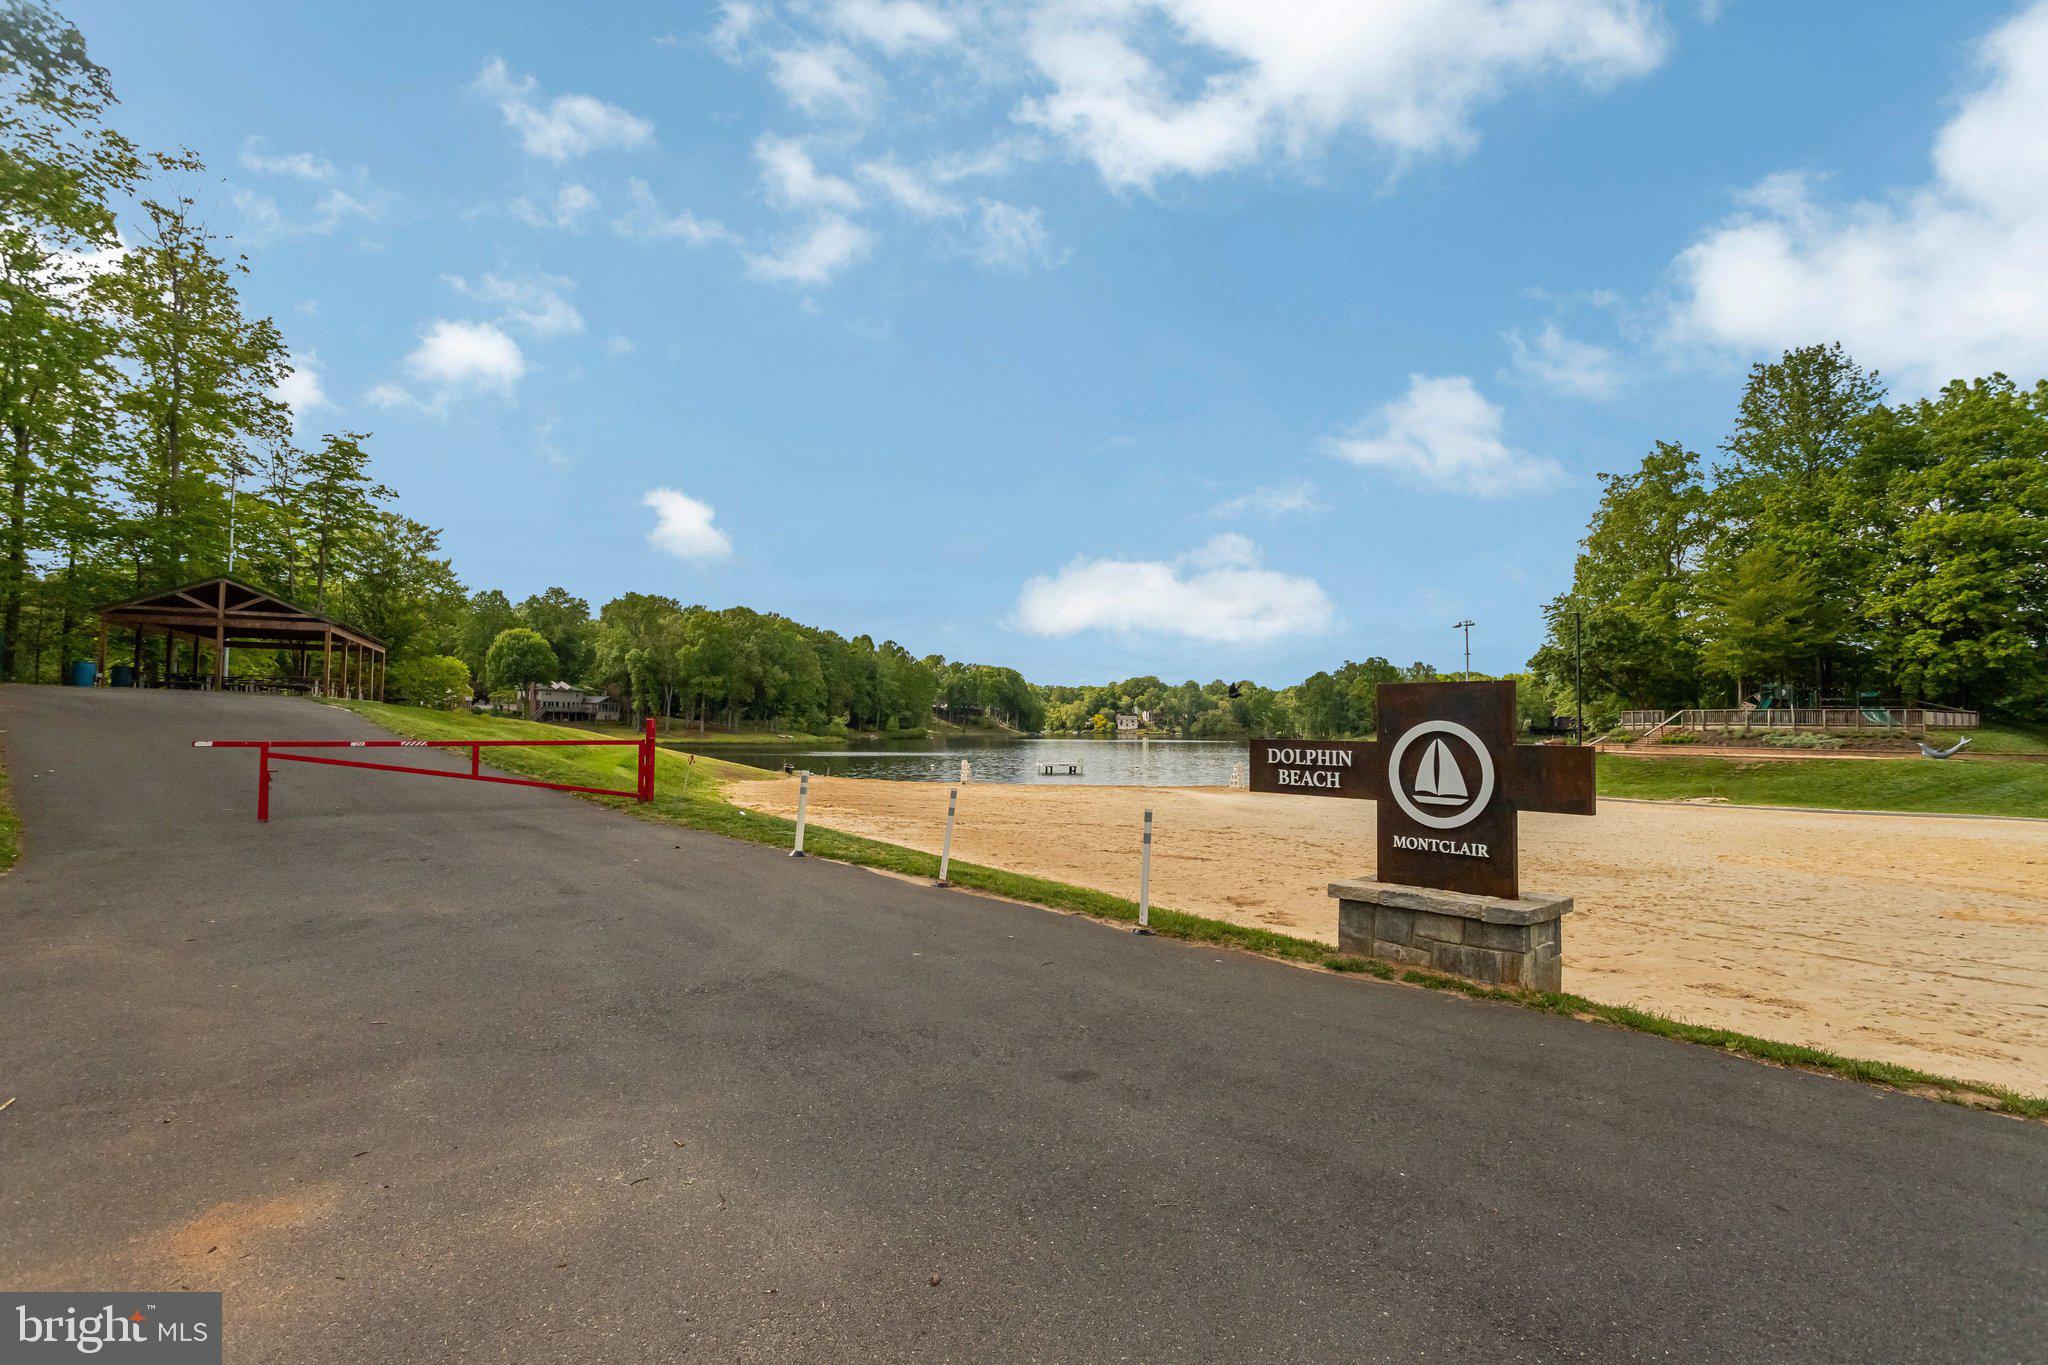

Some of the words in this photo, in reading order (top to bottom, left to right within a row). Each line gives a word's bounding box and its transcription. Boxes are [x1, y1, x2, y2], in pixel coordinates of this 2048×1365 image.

[1267, 748, 1352, 767] DOLPHIN
[1278, 769, 1341, 788] BEACH
[1393, 835, 1490, 858] MONTCLAIR
